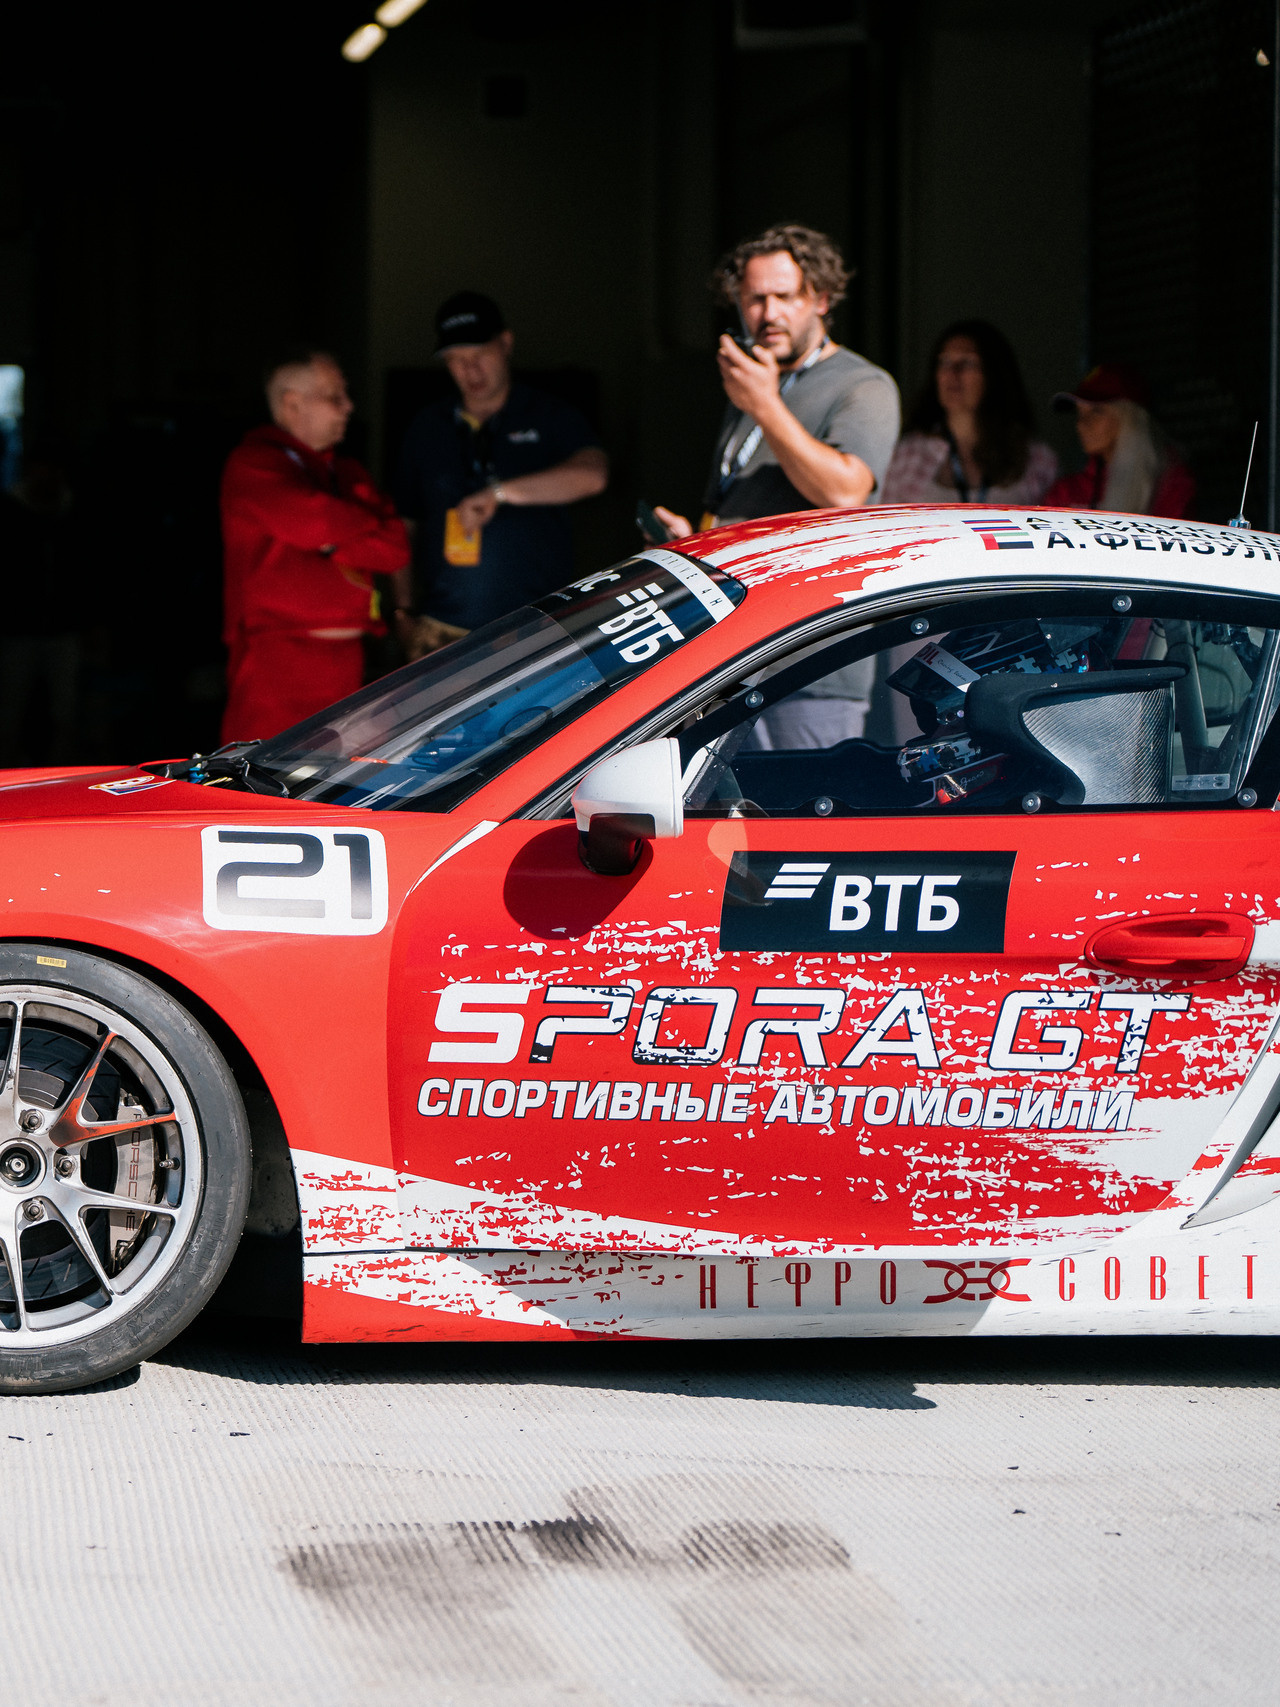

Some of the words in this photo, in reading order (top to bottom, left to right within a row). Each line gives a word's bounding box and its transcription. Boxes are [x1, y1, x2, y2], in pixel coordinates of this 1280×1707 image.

[598, 600, 685, 664] ВТБ
[216, 830, 373, 920] 21
[828, 875, 962, 932] ВТБ
[427, 982, 942, 1070] SPORA
[987, 989, 1193, 1074] GT
[417, 1077, 754, 1124] СПОРТИВНЫЕ
[763, 1084, 1136, 1133] АВТОМОБИЛИ
[125, 1113, 143, 1232] ORSCE
[699, 1259, 898, 1310] НЕФРО
[1058, 1254, 1258, 1302] СОВЕТ
